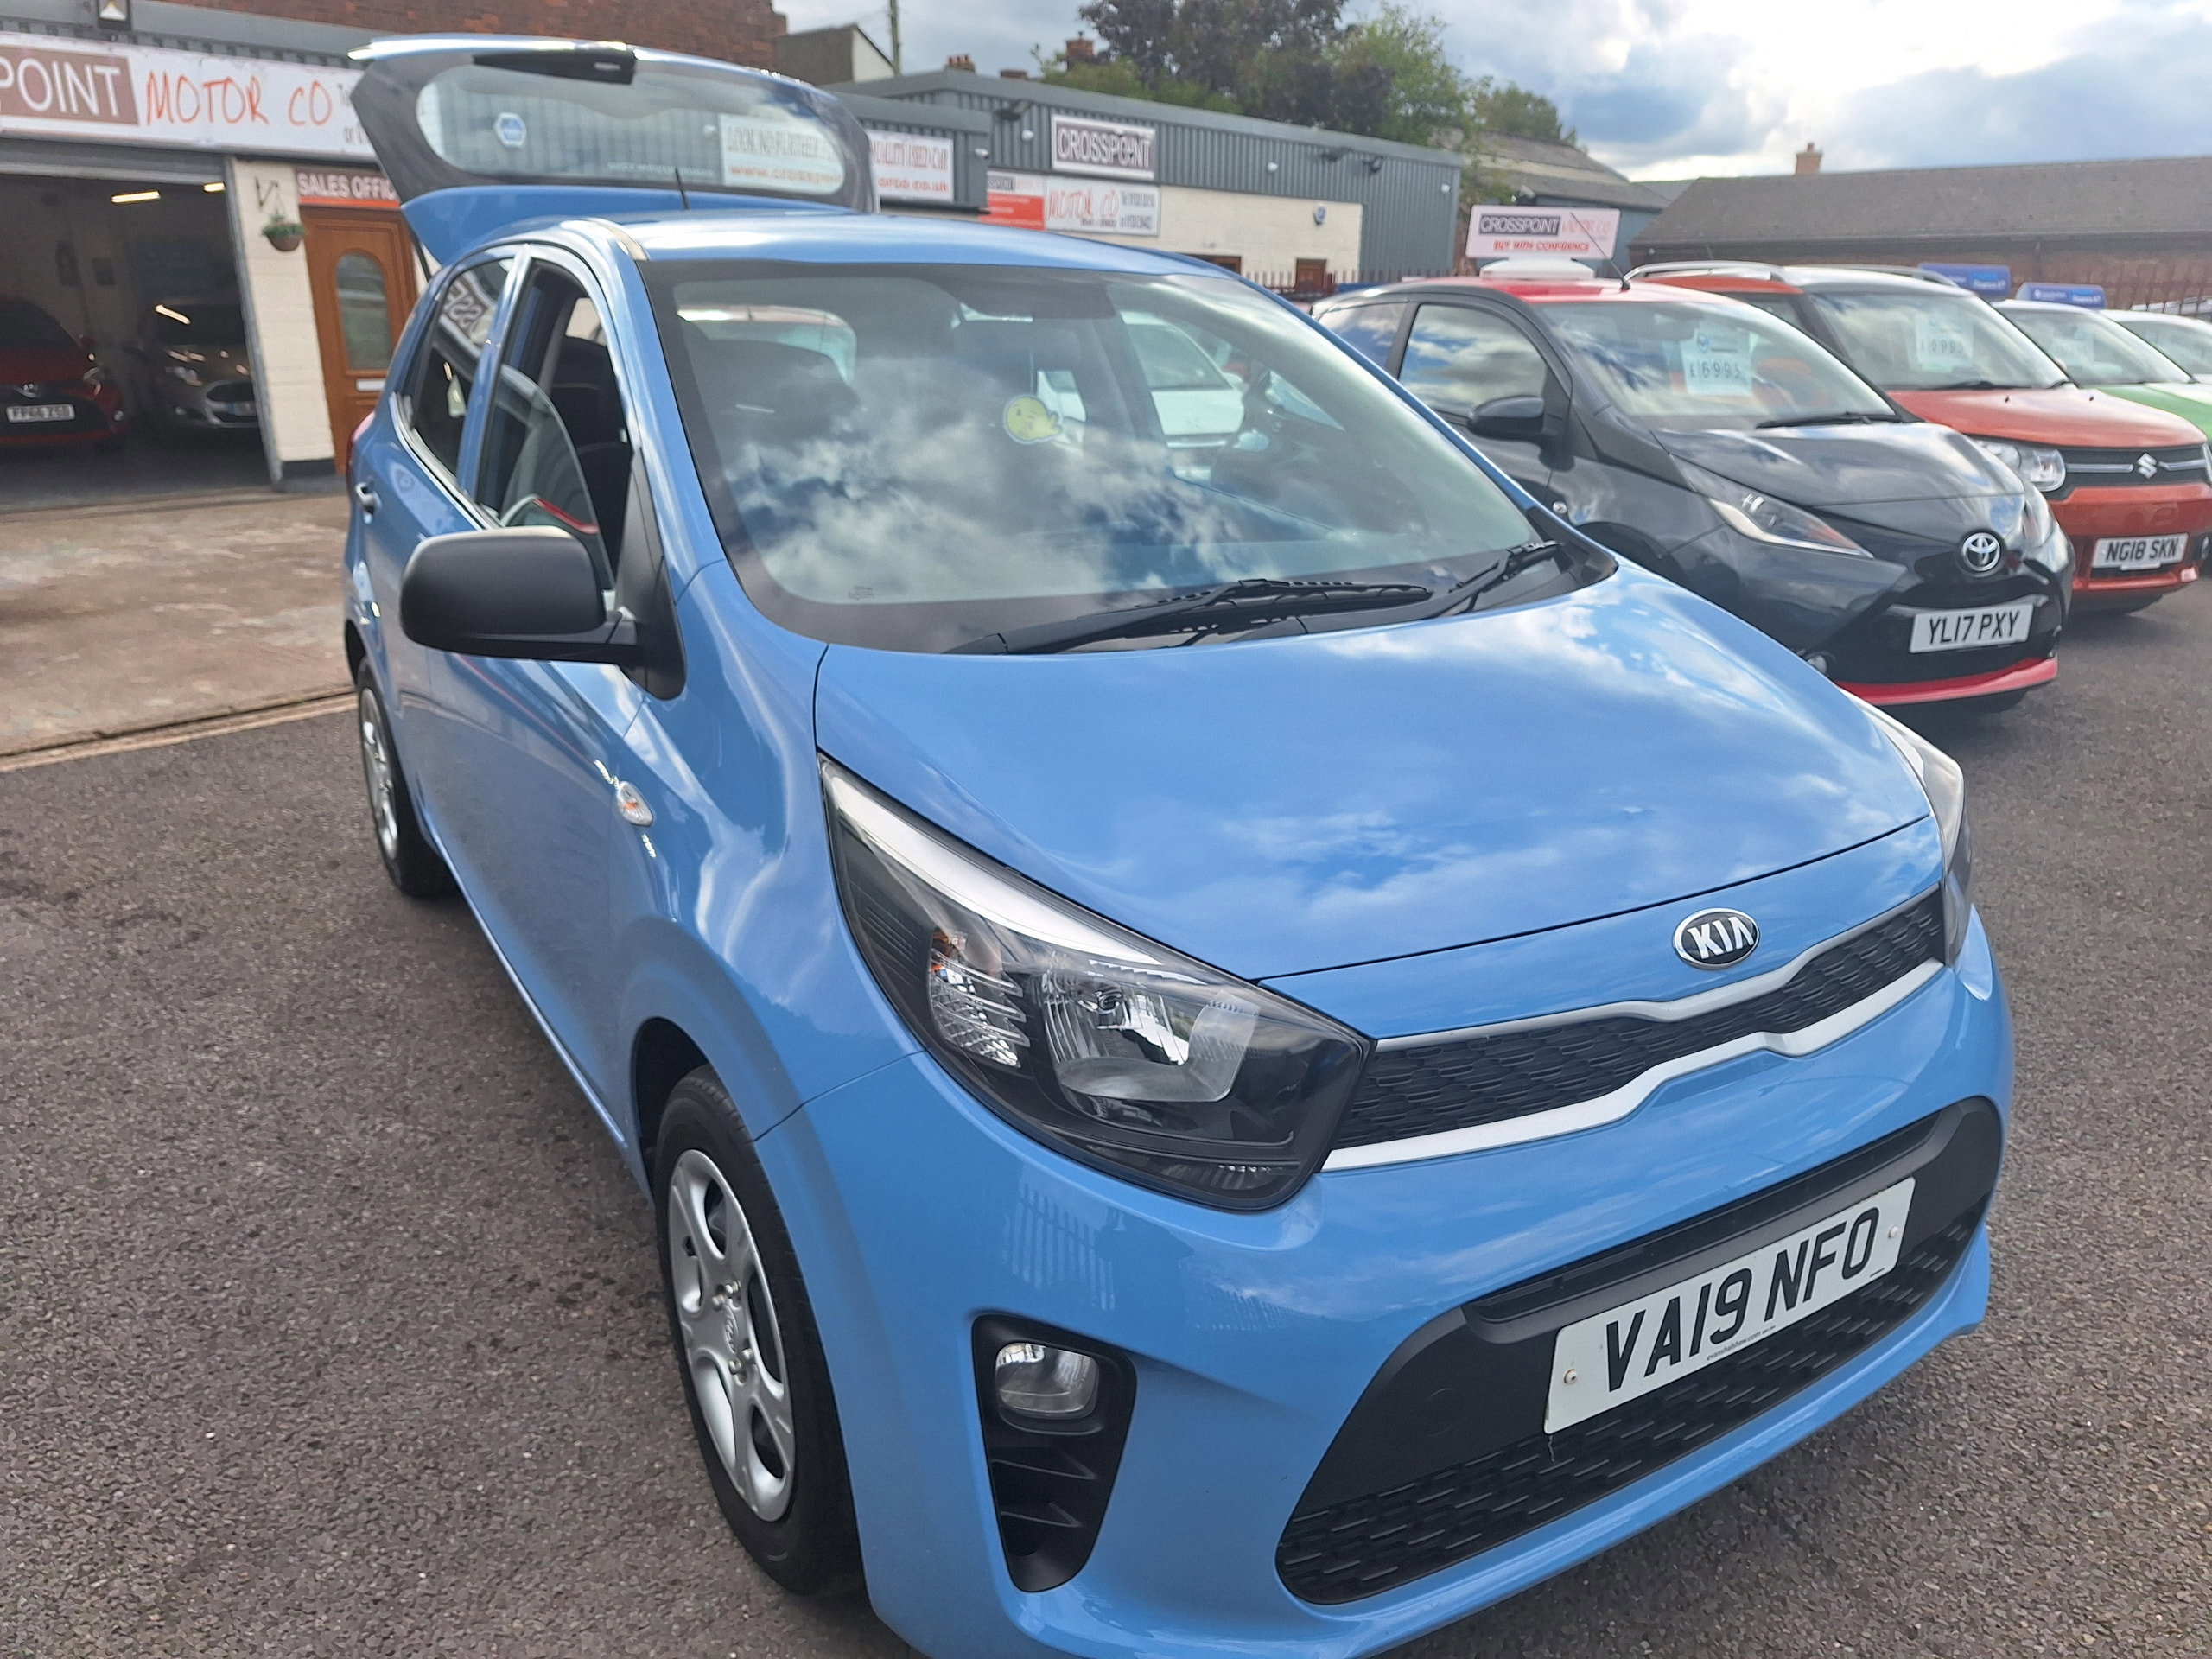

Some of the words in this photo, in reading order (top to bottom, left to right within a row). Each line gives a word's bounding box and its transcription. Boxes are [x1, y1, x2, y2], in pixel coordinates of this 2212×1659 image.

[145, 70, 270, 125] MOTOR
[288, 79, 334, 126] CO
[1057, 129, 1152, 168] CROSSPOINT
[297, 172, 350, 198] SALES
[1048, 188, 1092, 219] MOTOR
[1100, 190, 1121, 217] CO
[1480, 216, 1560, 235] CROSSPOINT
[2106, 536, 2145, 562] NG18
[2149, 537, 2179, 559] SKN
[1929, 612, 1974, 645] YL17
[1978, 610, 2020, 640] PXY
[1687, 916, 1755, 960] KIA
[1605, 1267, 1753, 1393] VA19
[1764, 1206, 1880, 1323] NFO
